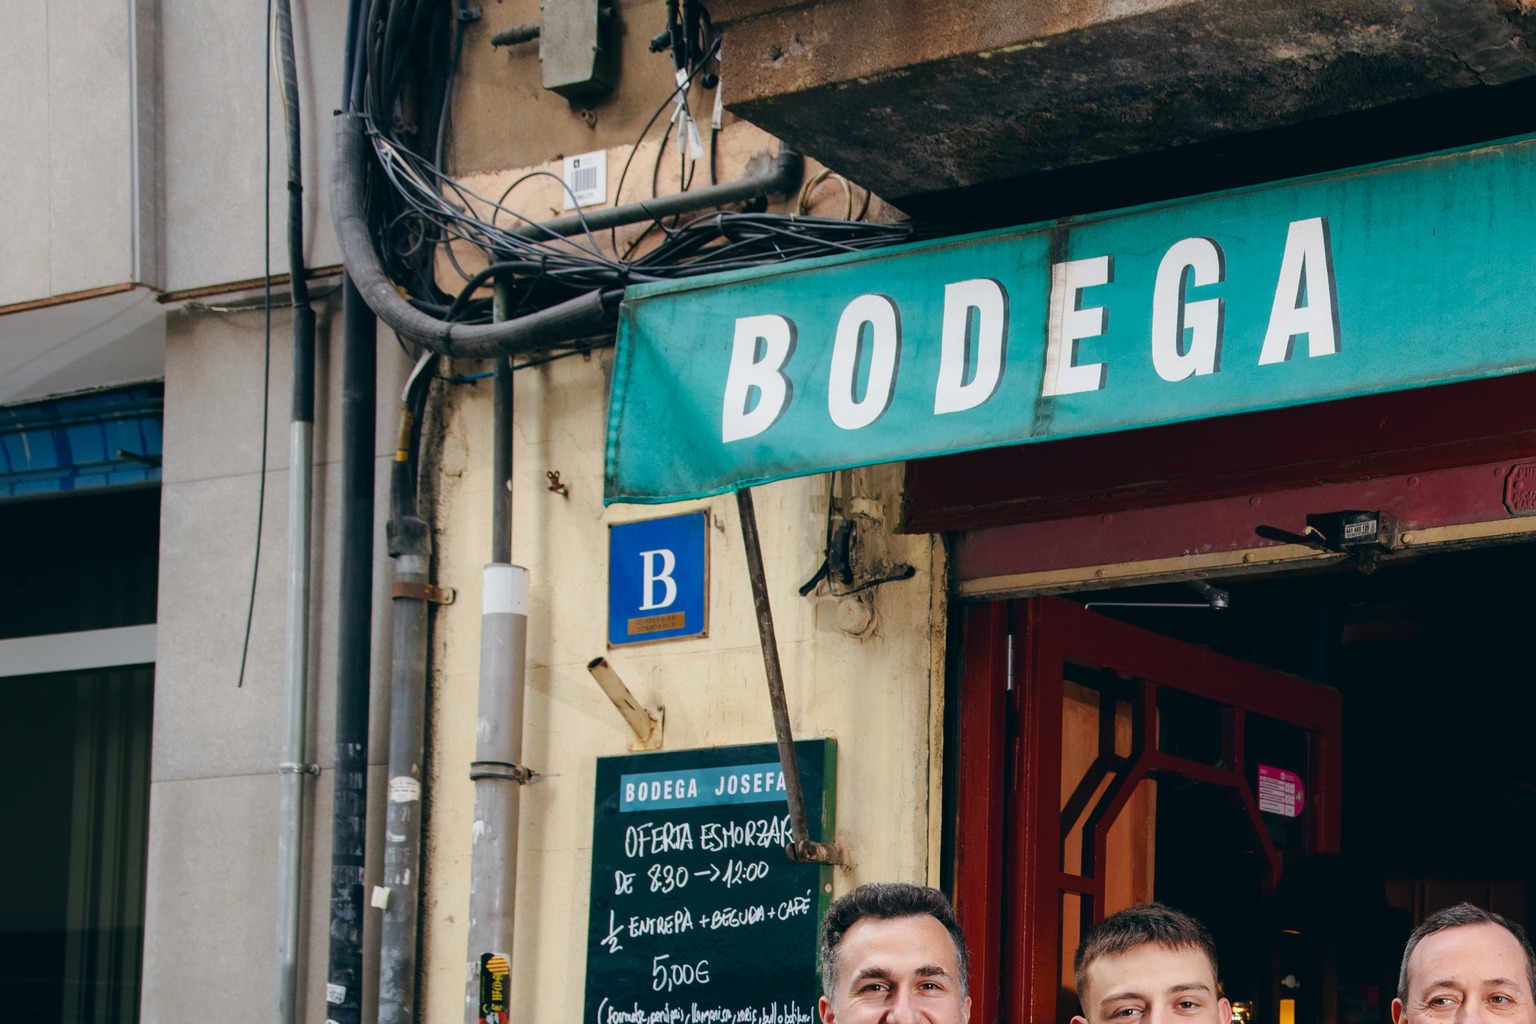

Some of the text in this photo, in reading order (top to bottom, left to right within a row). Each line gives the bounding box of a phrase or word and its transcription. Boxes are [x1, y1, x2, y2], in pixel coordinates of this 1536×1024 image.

[721, 216, 1342, 444] BODEGA
[638, 548, 678, 612] B
[625, 770, 787, 803] BODEGA JOSEFA
[625, 814, 796, 858] OFERTA ESMORZAR
[614, 860, 770, 895] DE 8:30 12:00
[652, 953, 710, 993] 5,00€
